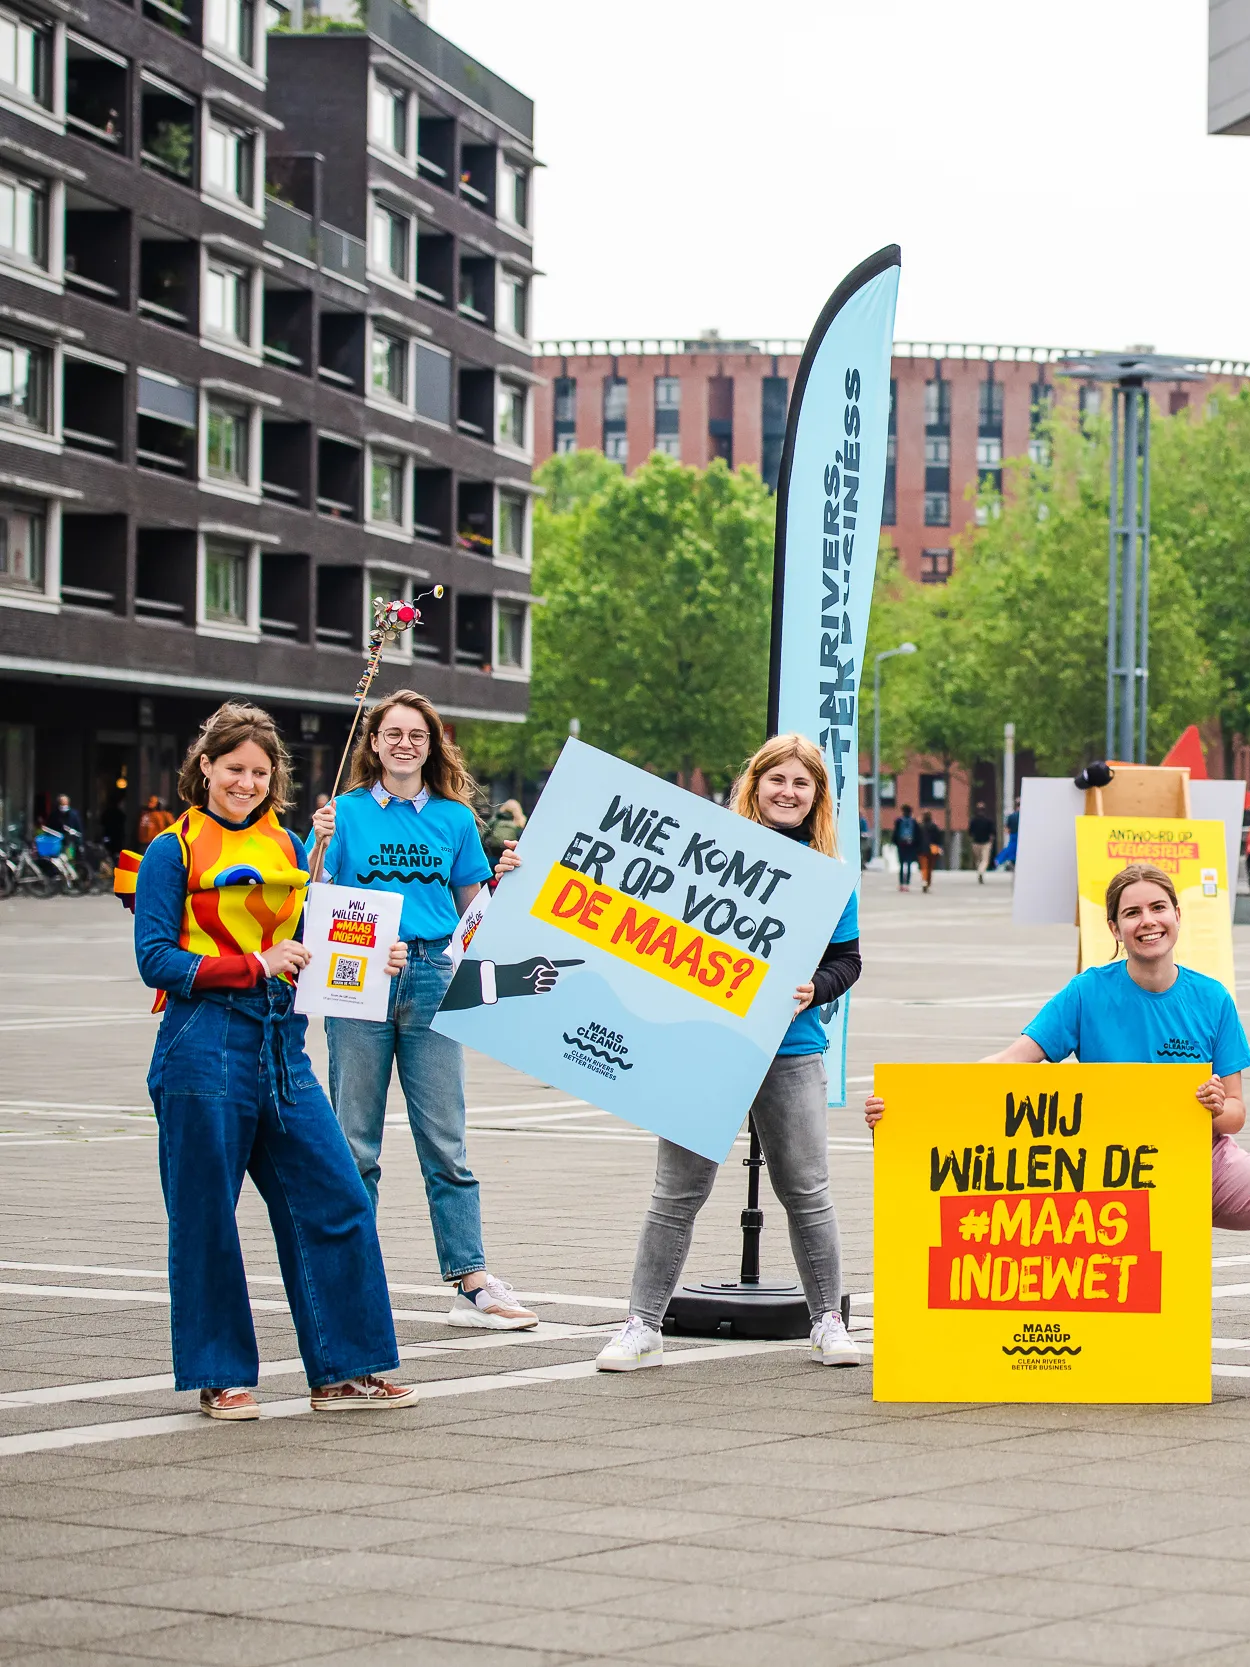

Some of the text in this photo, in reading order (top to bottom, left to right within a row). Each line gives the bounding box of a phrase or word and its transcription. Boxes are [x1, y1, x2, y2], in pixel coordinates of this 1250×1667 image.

[819, 449, 844, 669] RIVERS,
[379, 843, 430, 856] MAAS
[368, 854, 443, 868] CLEANUP
[559, 832, 616, 886] ER
[619, 857, 675, 901] OP
[348, 900, 366, 911] WIJ
[336, 921, 372, 934] #MAAS
[366, 912, 379, 923] DE
[332, 930, 373, 946] INDEWET
[551, 878, 755, 999] DE MAAS?
[576, 1026, 629, 1055] CLEANUP
[588, 1021, 624, 1043] MAAS
[1169, 1038, 1189, 1046] MAAS
[1163, 1042, 1195, 1051] CLEANUP
[563, 1052, 617, 1081] BETTER BUSINESS
[571, 1050, 615, 1073] CLEAN RIVERS
[1004, 1090, 1083, 1138] WIJ
[1102, 1144, 1159, 1190] DE
[958, 1196, 1129, 1248] #MAAS
[949, 1252, 1138, 1304] INDEWET
[1013, 1333, 1071, 1343] CLEANUP
[1023, 1323, 1061, 1333] MAAS
